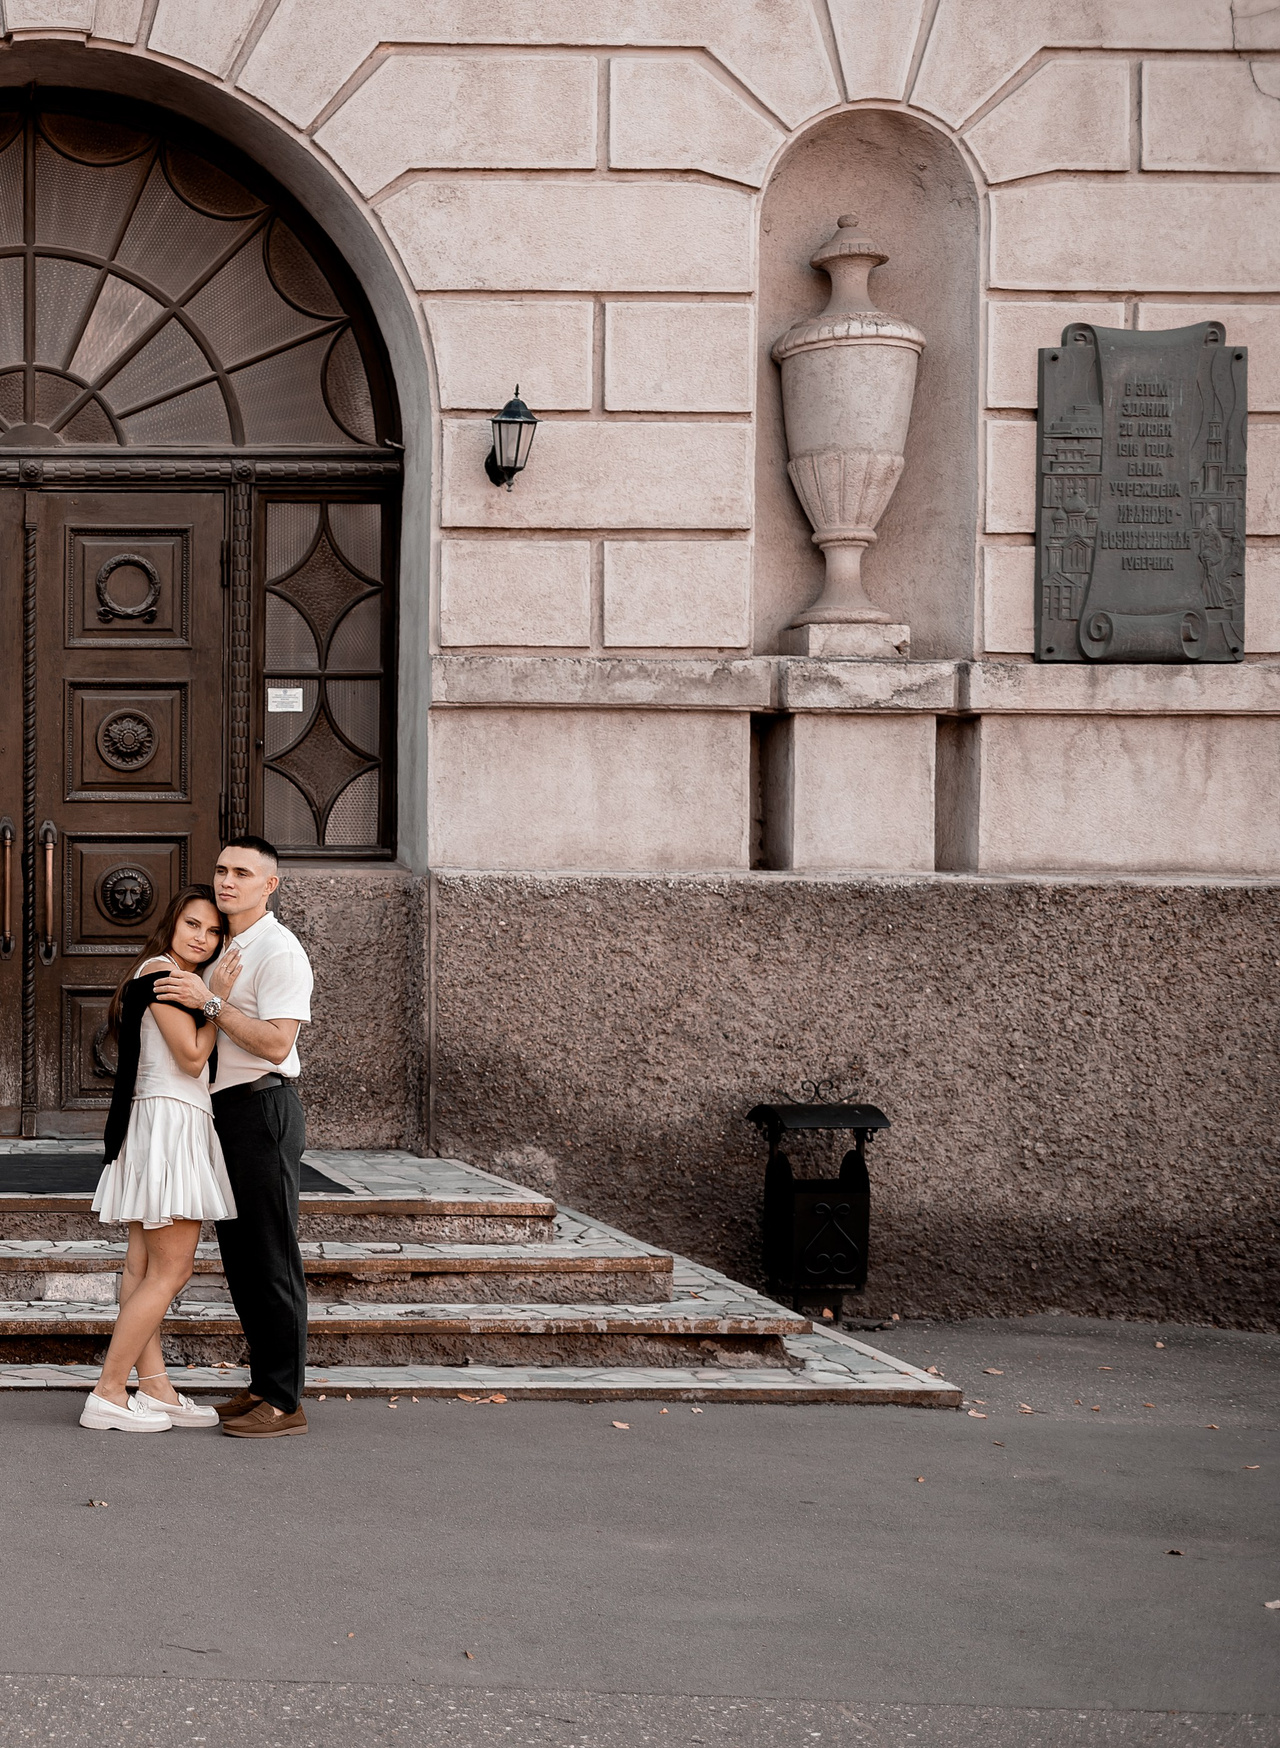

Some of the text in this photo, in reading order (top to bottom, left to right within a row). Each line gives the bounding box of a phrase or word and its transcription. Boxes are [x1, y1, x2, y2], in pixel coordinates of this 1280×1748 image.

[1124, 383, 1169, 397] В ЭТОМ
[1122, 402, 1170, 417] ЗДАНИИ
[1119, 422, 1172, 437] 20 ИЮНЯ
[1117, 443, 1175, 458] 1918 ГОДА
[1127, 463, 1163, 477] БЫЛА
[1109, 482, 1181, 498] УЧРЕЖДЕНА
[1101, 530, 1191, 550] ВОЗНЕСЕНСКАЯ
[1122, 557, 1174, 571] ГУБЕРНИЯ
